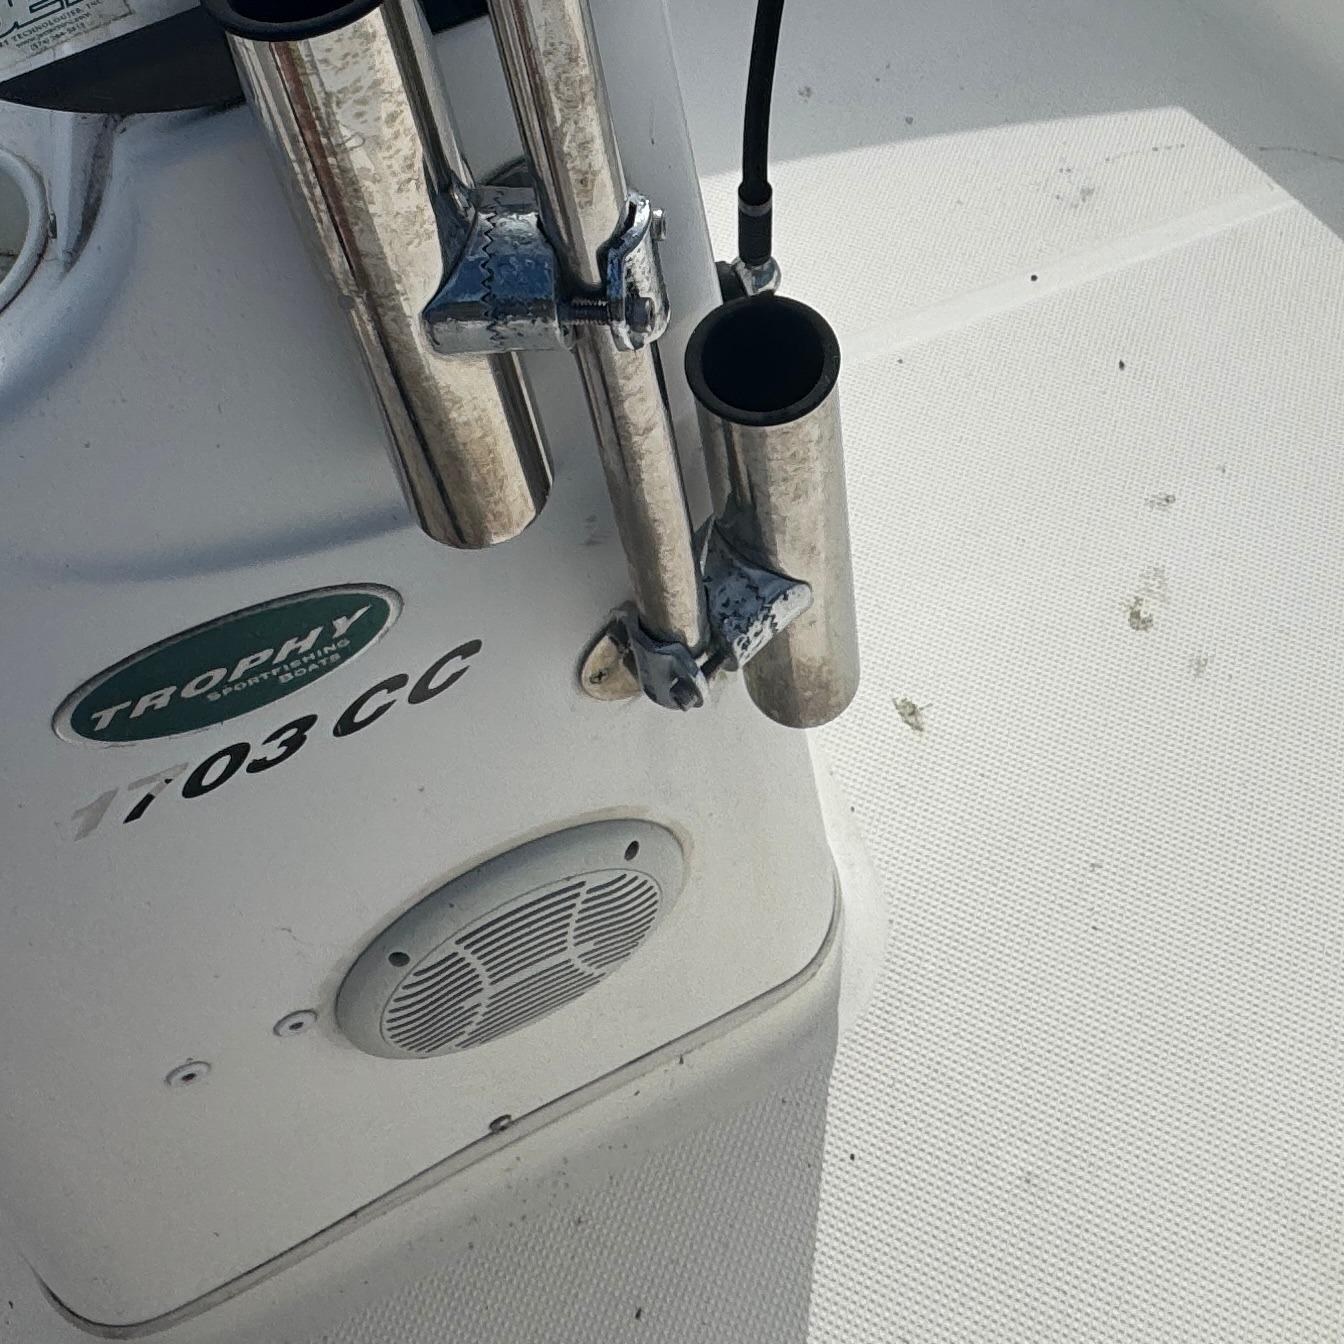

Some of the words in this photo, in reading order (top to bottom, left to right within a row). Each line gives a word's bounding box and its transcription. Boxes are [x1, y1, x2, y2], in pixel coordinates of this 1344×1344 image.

[90, 604, 372, 732] TROPHY
[206, 637, 351, 702] SPORTFISHING
[278, 652, 342, 684] BOATS
[71, 714, 318, 843] 1703
[333, 639, 483, 738] CC
